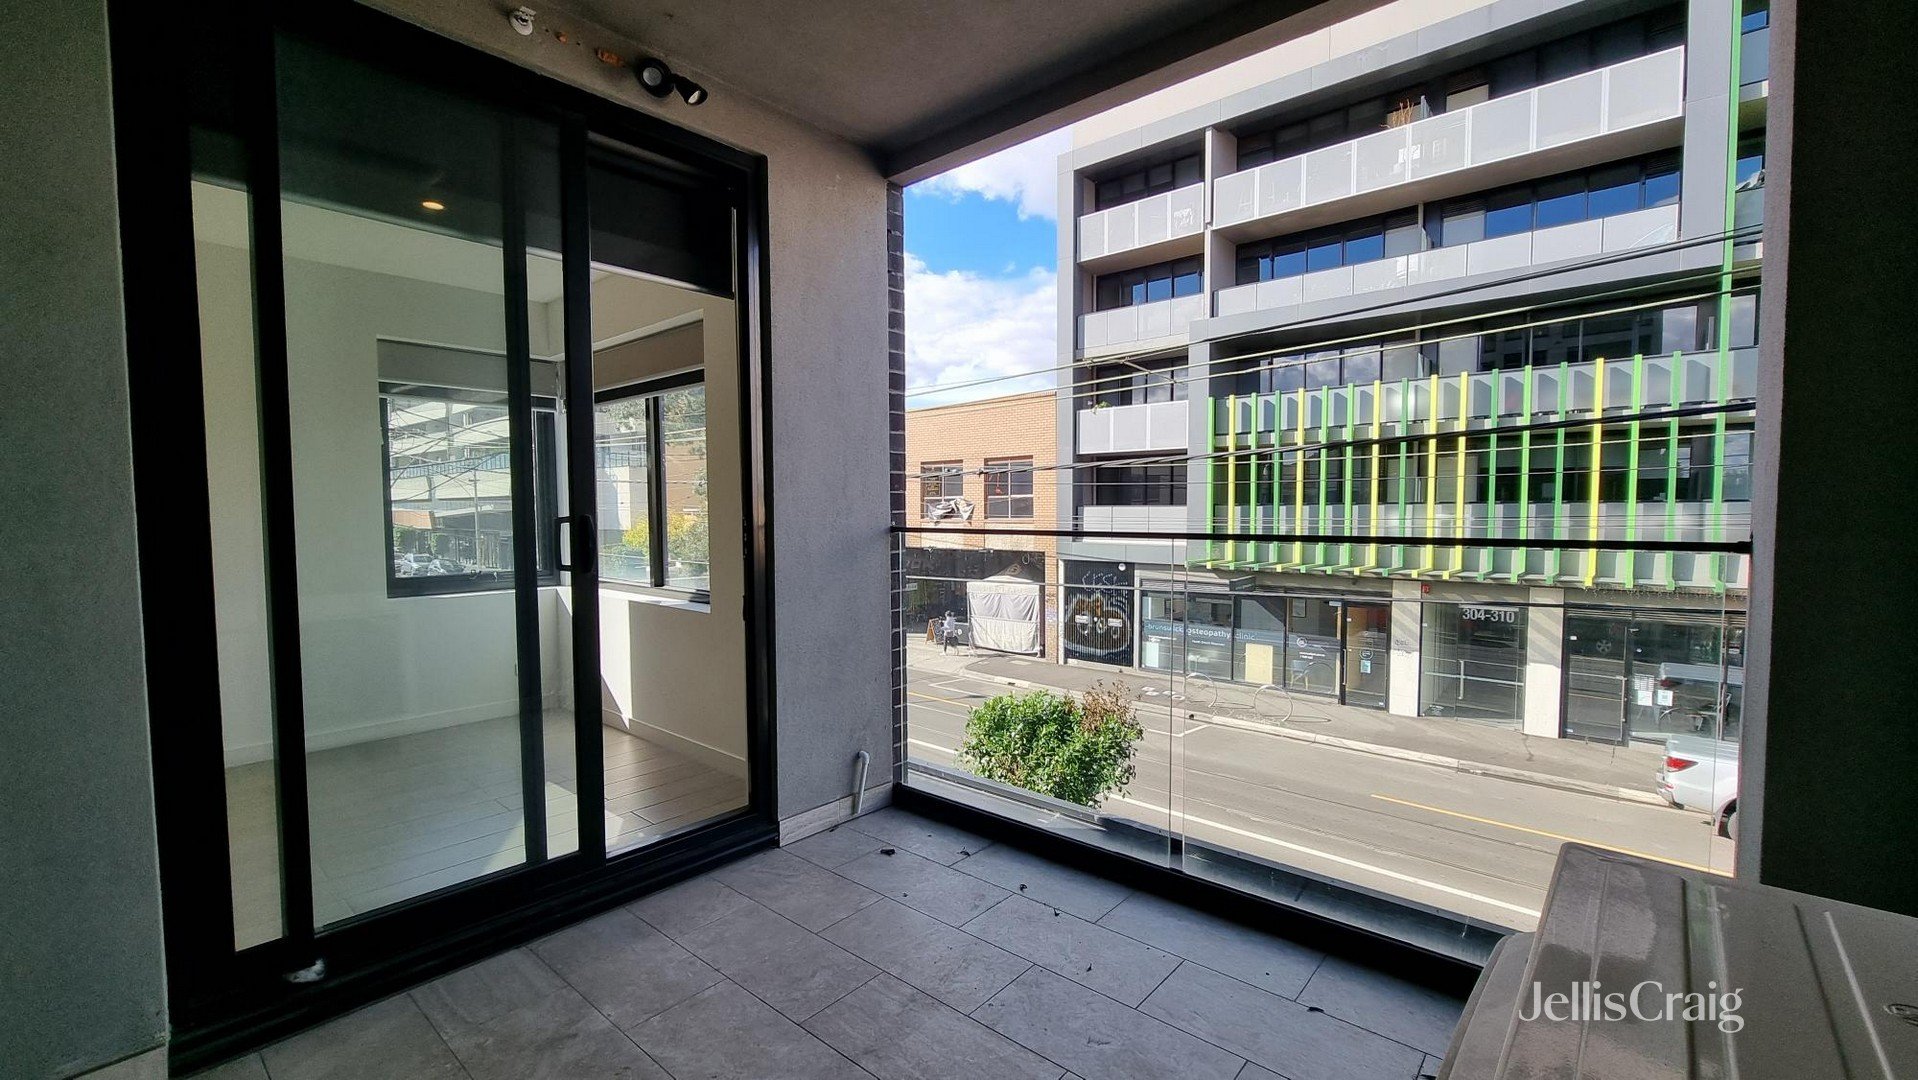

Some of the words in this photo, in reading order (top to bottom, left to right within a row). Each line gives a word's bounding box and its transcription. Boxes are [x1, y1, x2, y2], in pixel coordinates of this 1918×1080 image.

[1462, 608, 1515, 623] 304-310
[1187, 627, 1232, 639] osteopathy
[1234, 631, 1256, 641] clinic
